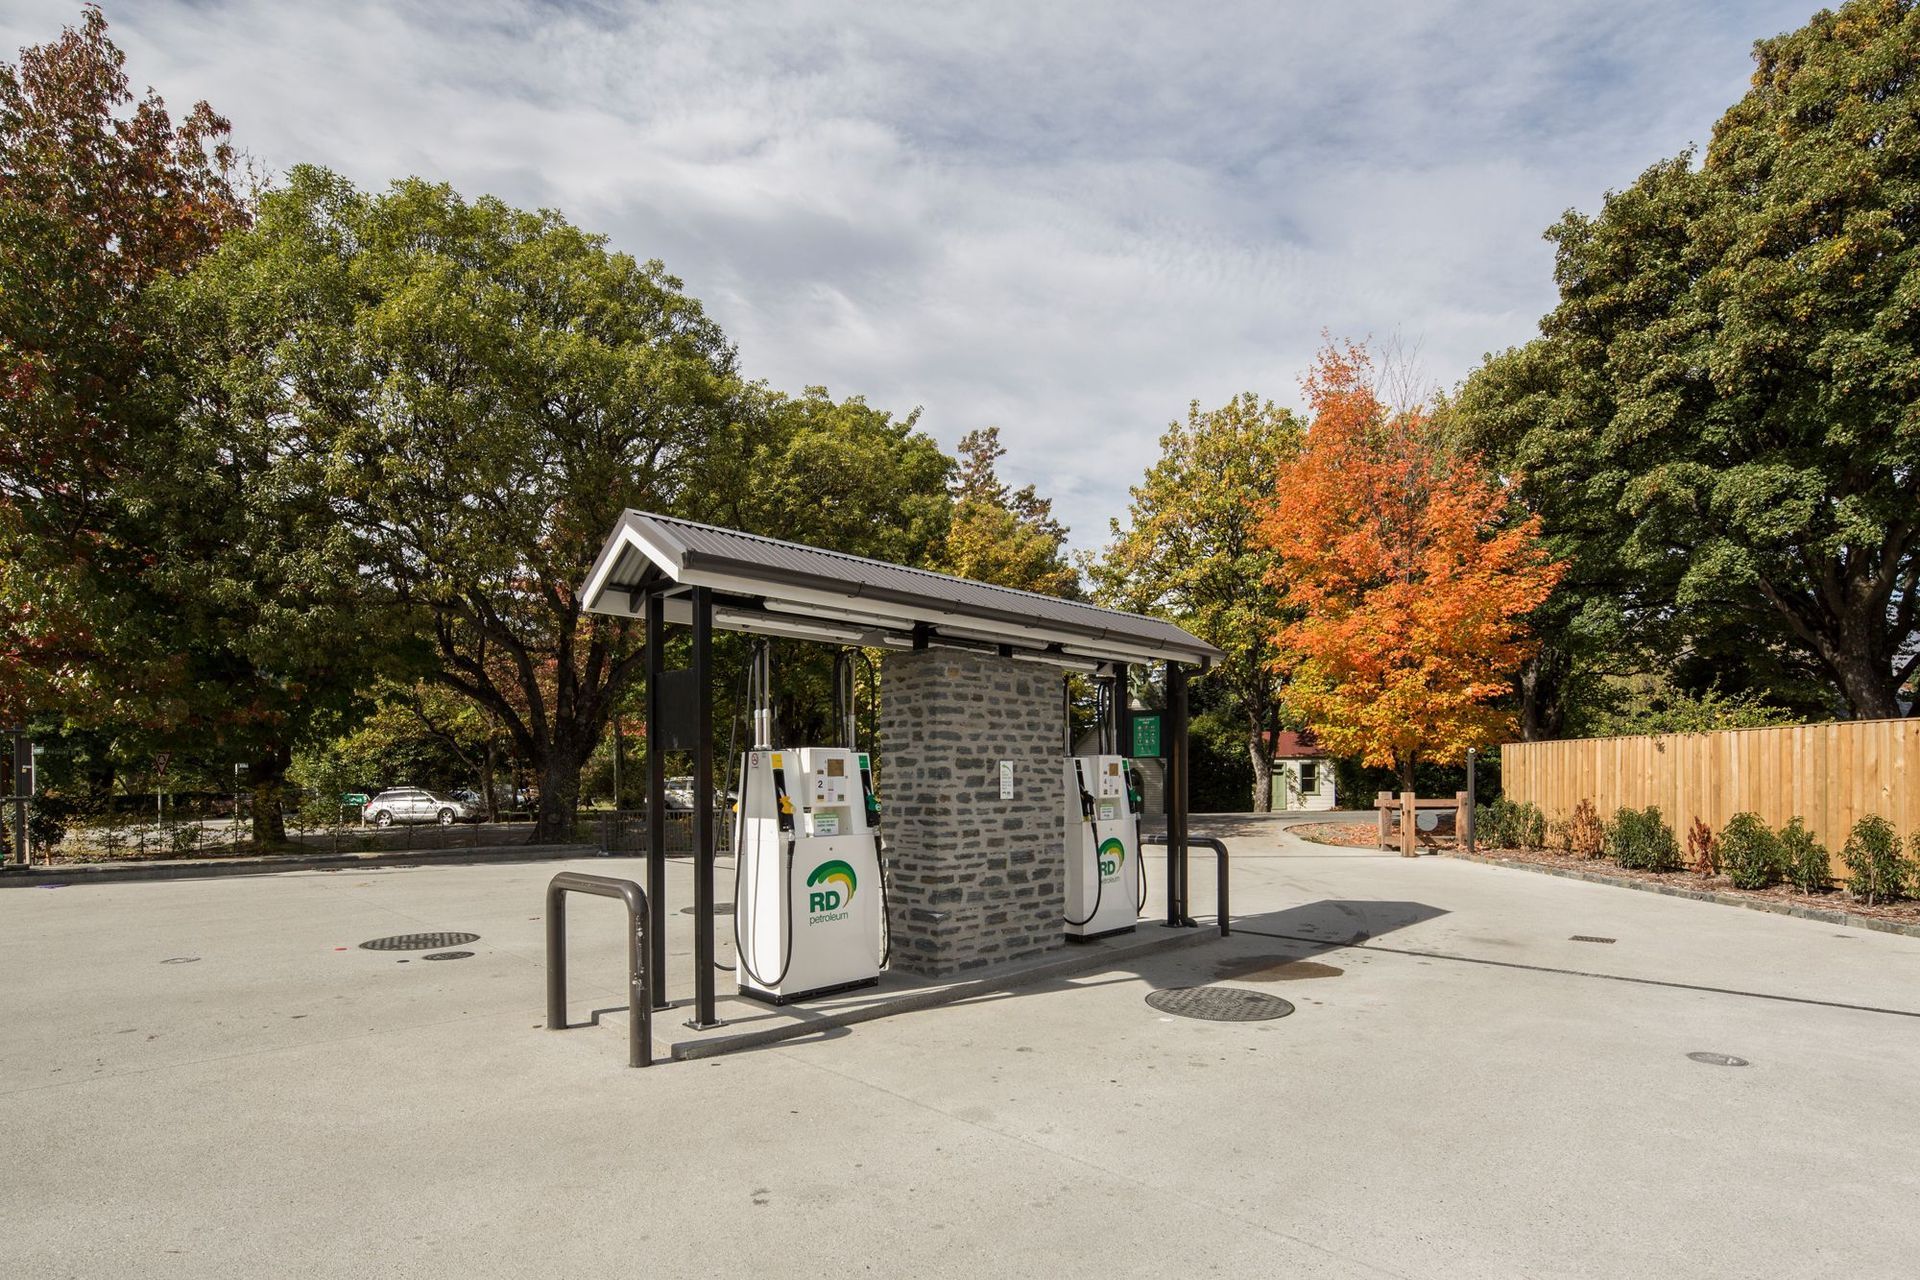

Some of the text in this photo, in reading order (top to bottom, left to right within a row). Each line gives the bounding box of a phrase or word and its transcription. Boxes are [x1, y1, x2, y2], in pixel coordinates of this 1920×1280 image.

[818, 780, 823, 788] 2
[1100, 860, 1116, 876] RD
[810, 891, 840, 913] RD
[810, 912, 848, 926] petroleum
